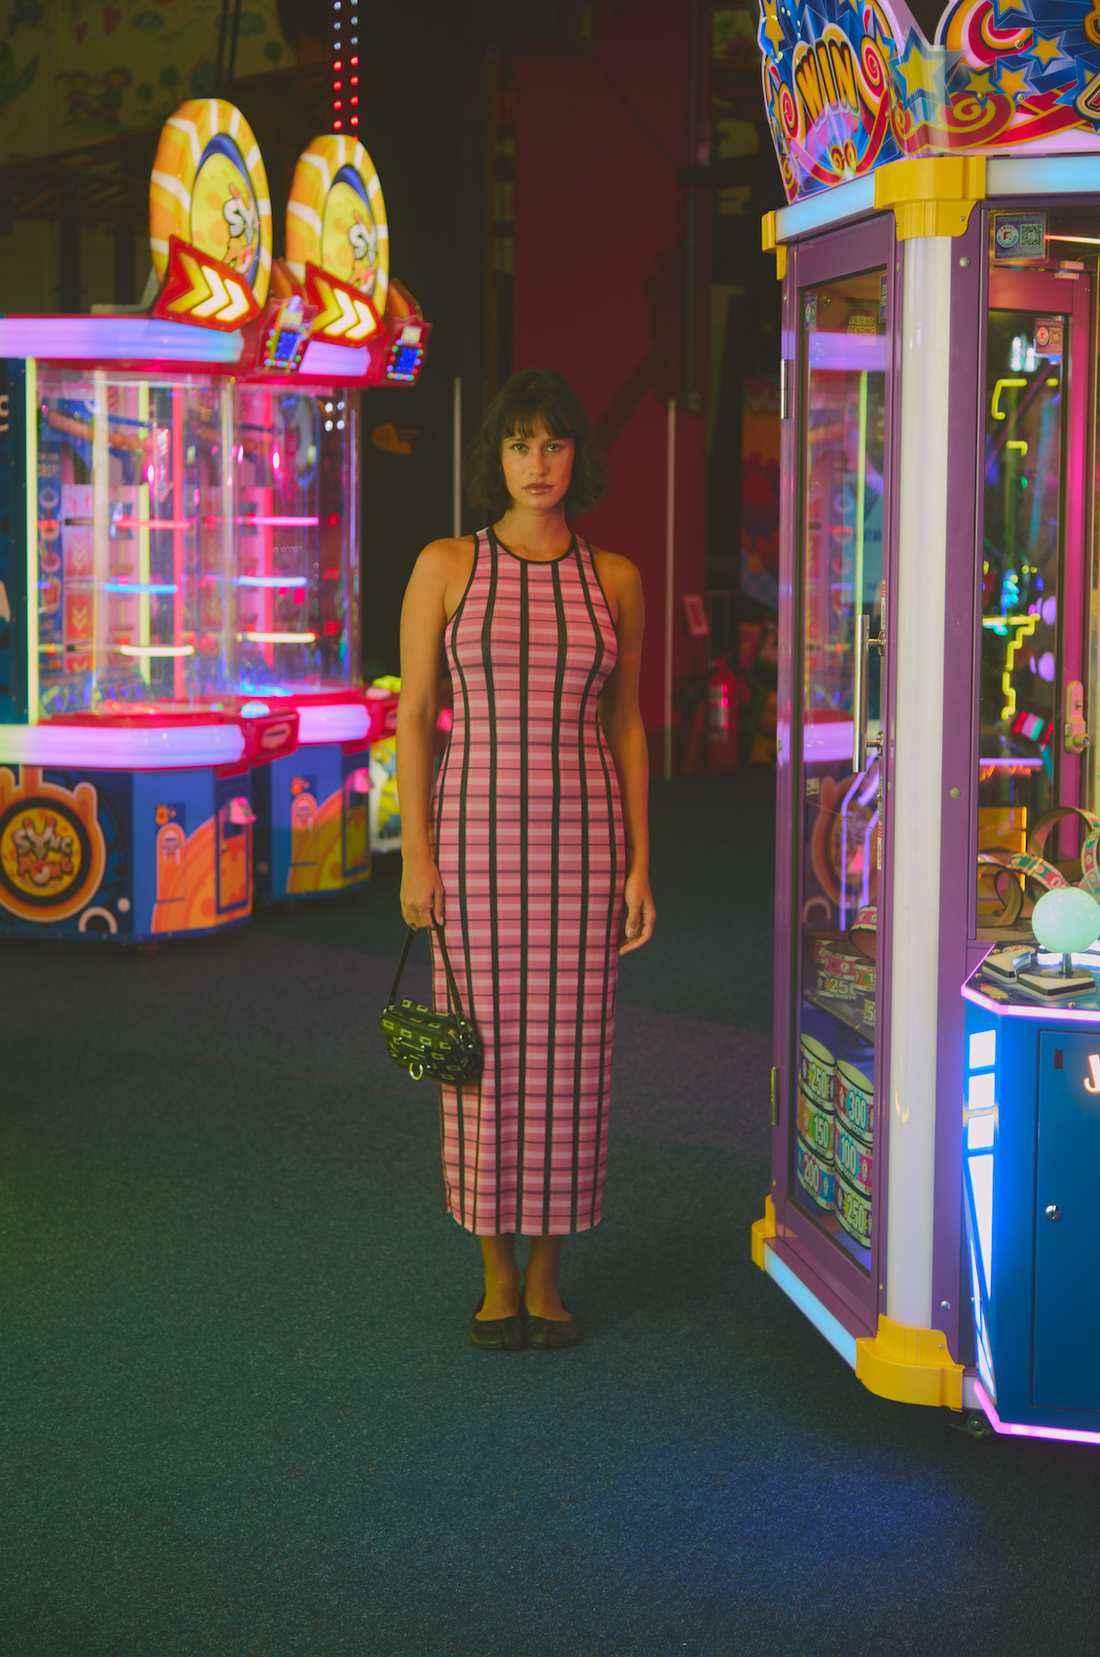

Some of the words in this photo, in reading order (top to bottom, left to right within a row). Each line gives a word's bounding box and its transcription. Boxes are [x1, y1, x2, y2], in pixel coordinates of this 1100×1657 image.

[796, 38, 858, 120] WIN
[847, 325, 876, 335] PENDING
[849, 315, 874, 326] PATENT
[12, 816, 73, 858] SYNC
[811, 1061, 827, 1099] 250
[849, 1088, 867, 1129] 300
[814, 1113, 829, 1146] 150
[804, 1153, 820, 1194] 200
[840, 1135, 857, 1176] 100
[847, 1192, 865, 1236] 250
